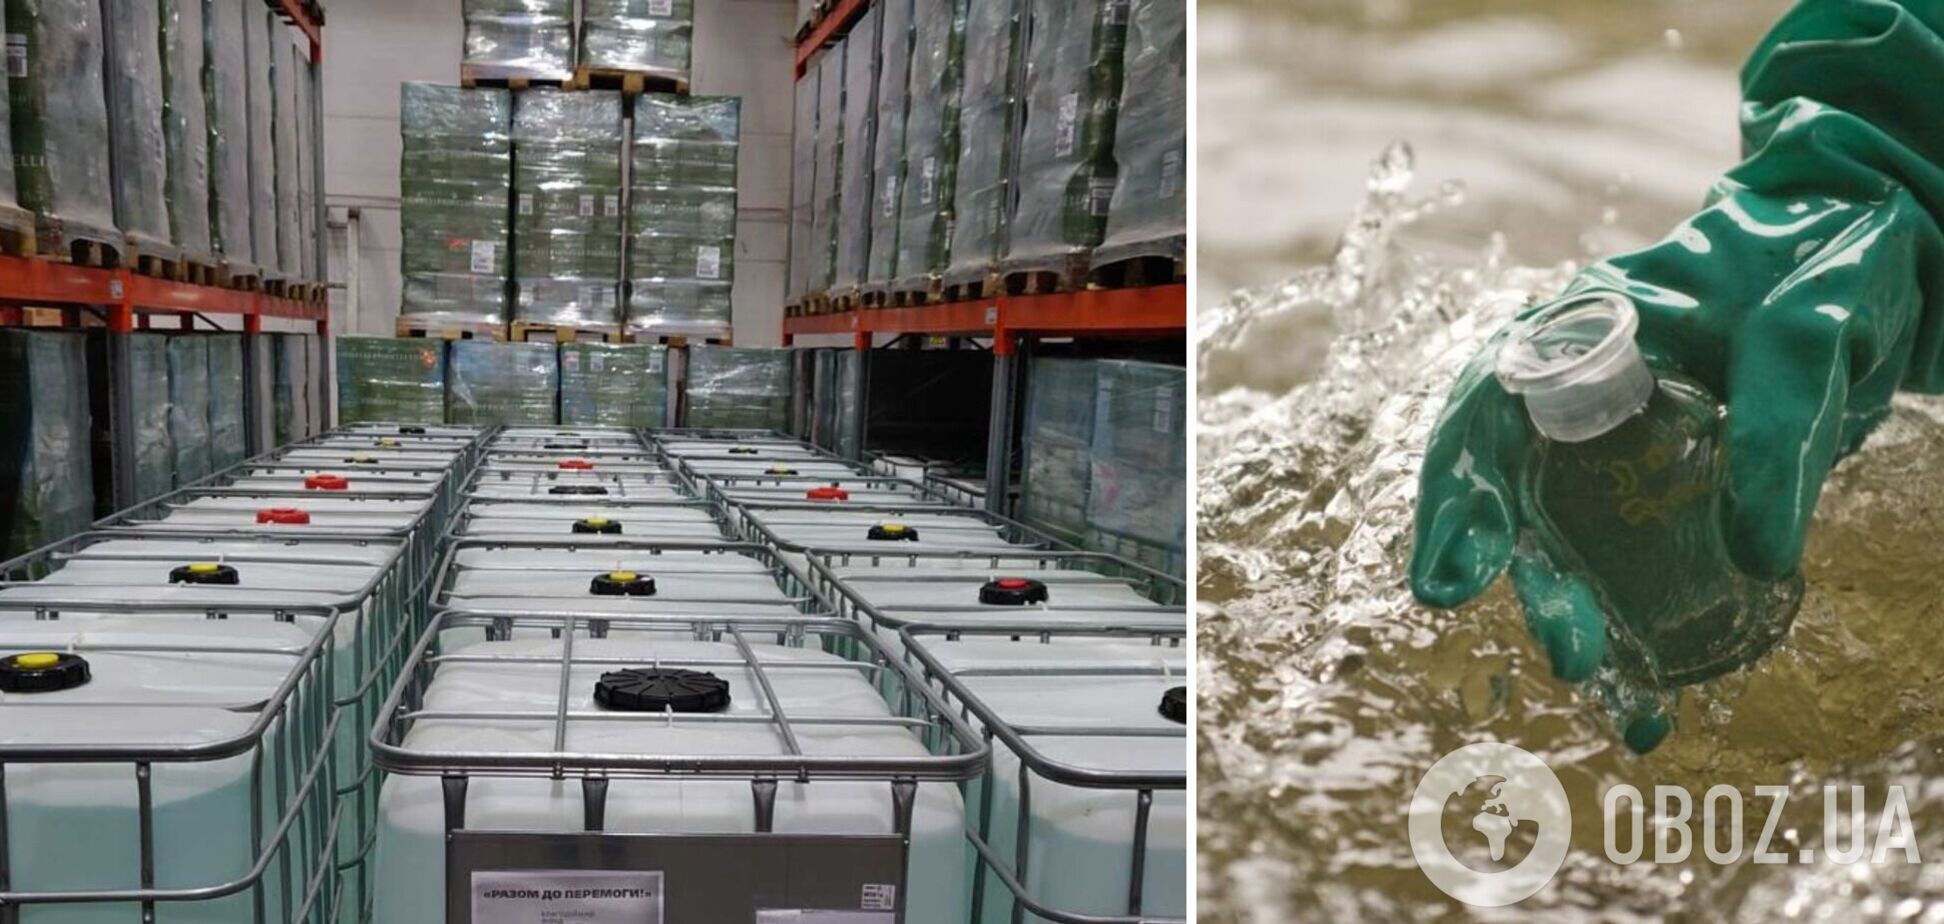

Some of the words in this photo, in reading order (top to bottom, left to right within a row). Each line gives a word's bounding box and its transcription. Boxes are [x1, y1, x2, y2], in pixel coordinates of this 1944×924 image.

[483, 889, 539, 899] «РАЗОМ
[541, 889, 562, 900] ДО
[564, 888, 652, 899] ПЕРЕМОГИ!»
